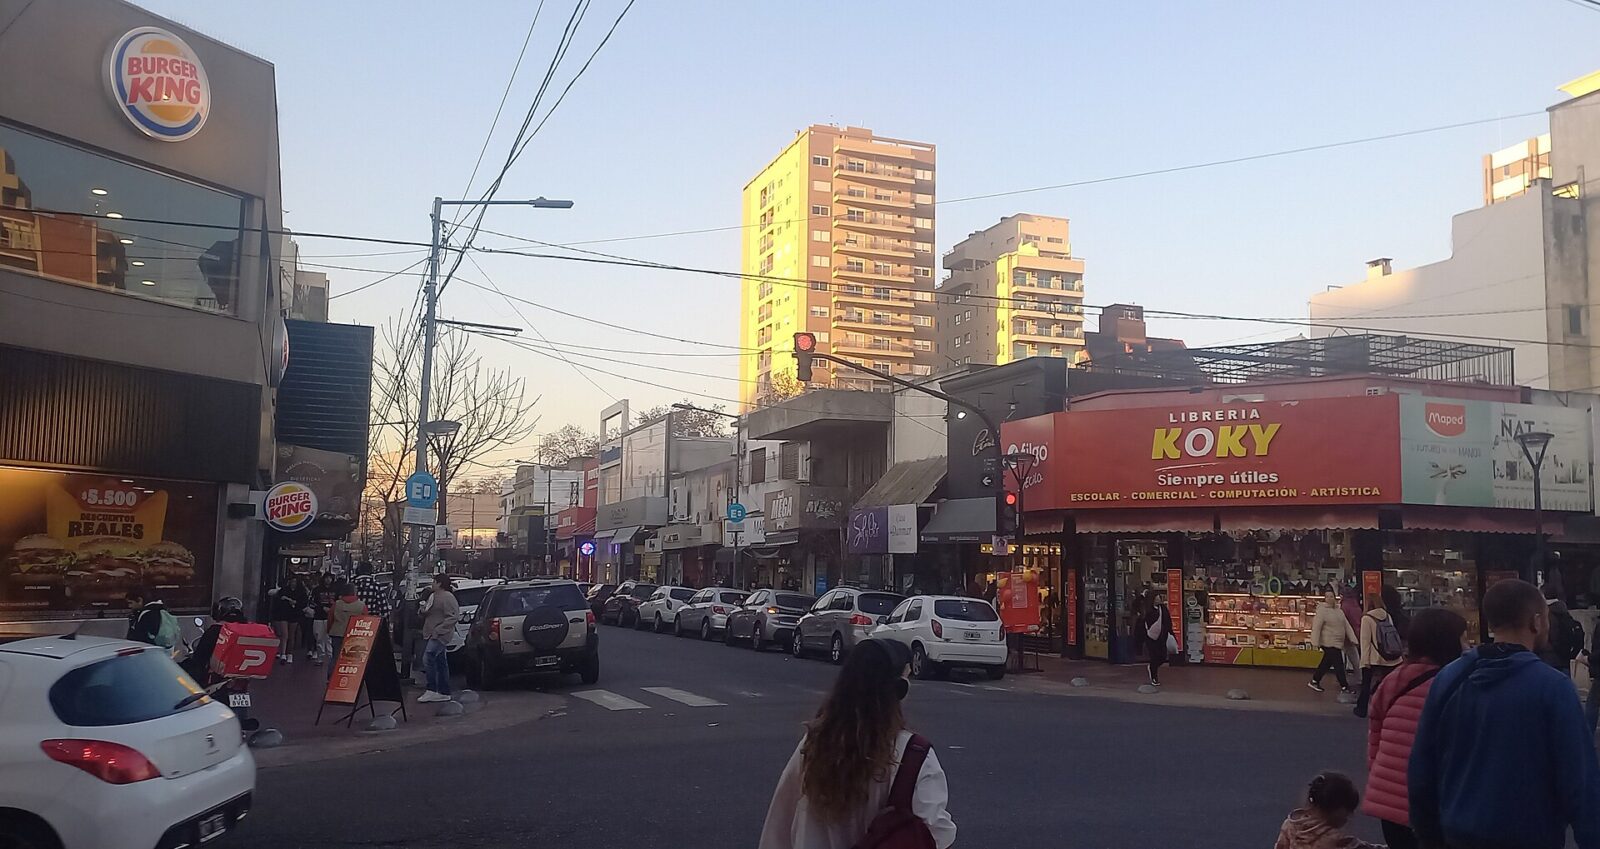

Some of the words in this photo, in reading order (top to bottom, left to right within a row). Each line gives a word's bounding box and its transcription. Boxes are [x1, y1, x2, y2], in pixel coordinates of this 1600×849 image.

[128, 57, 198, 80] BURGER
[128, 77, 201, 104] KING
[1169, 408, 1260, 423] LIBRERIA
[1429, 412, 1463, 425] Maped
[1152, 423, 1281, 460] KOKY
[1158, 473, 1224, 487] Siempre
[1230, 470, 1279, 484] útiles
[81, 488, 137, 507] $5.500
[268, 492, 310, 509] BURGER
[1070, 492, 1120, 502] ESCOLAR
[1131, 490, 1197, 500] COMERCIAL
[1209, 486, 1297, 499] COMPUTACIÓN
[269, 500, 311, 519] KING
[770, 496, 793, 520] MEGA
[80, 513, 135, 523] DESCUENTOS
[68, 521, 144, 539] REALES
[347, 628, 373, 638] Ahorro
[355, 619, 372, 630] King
